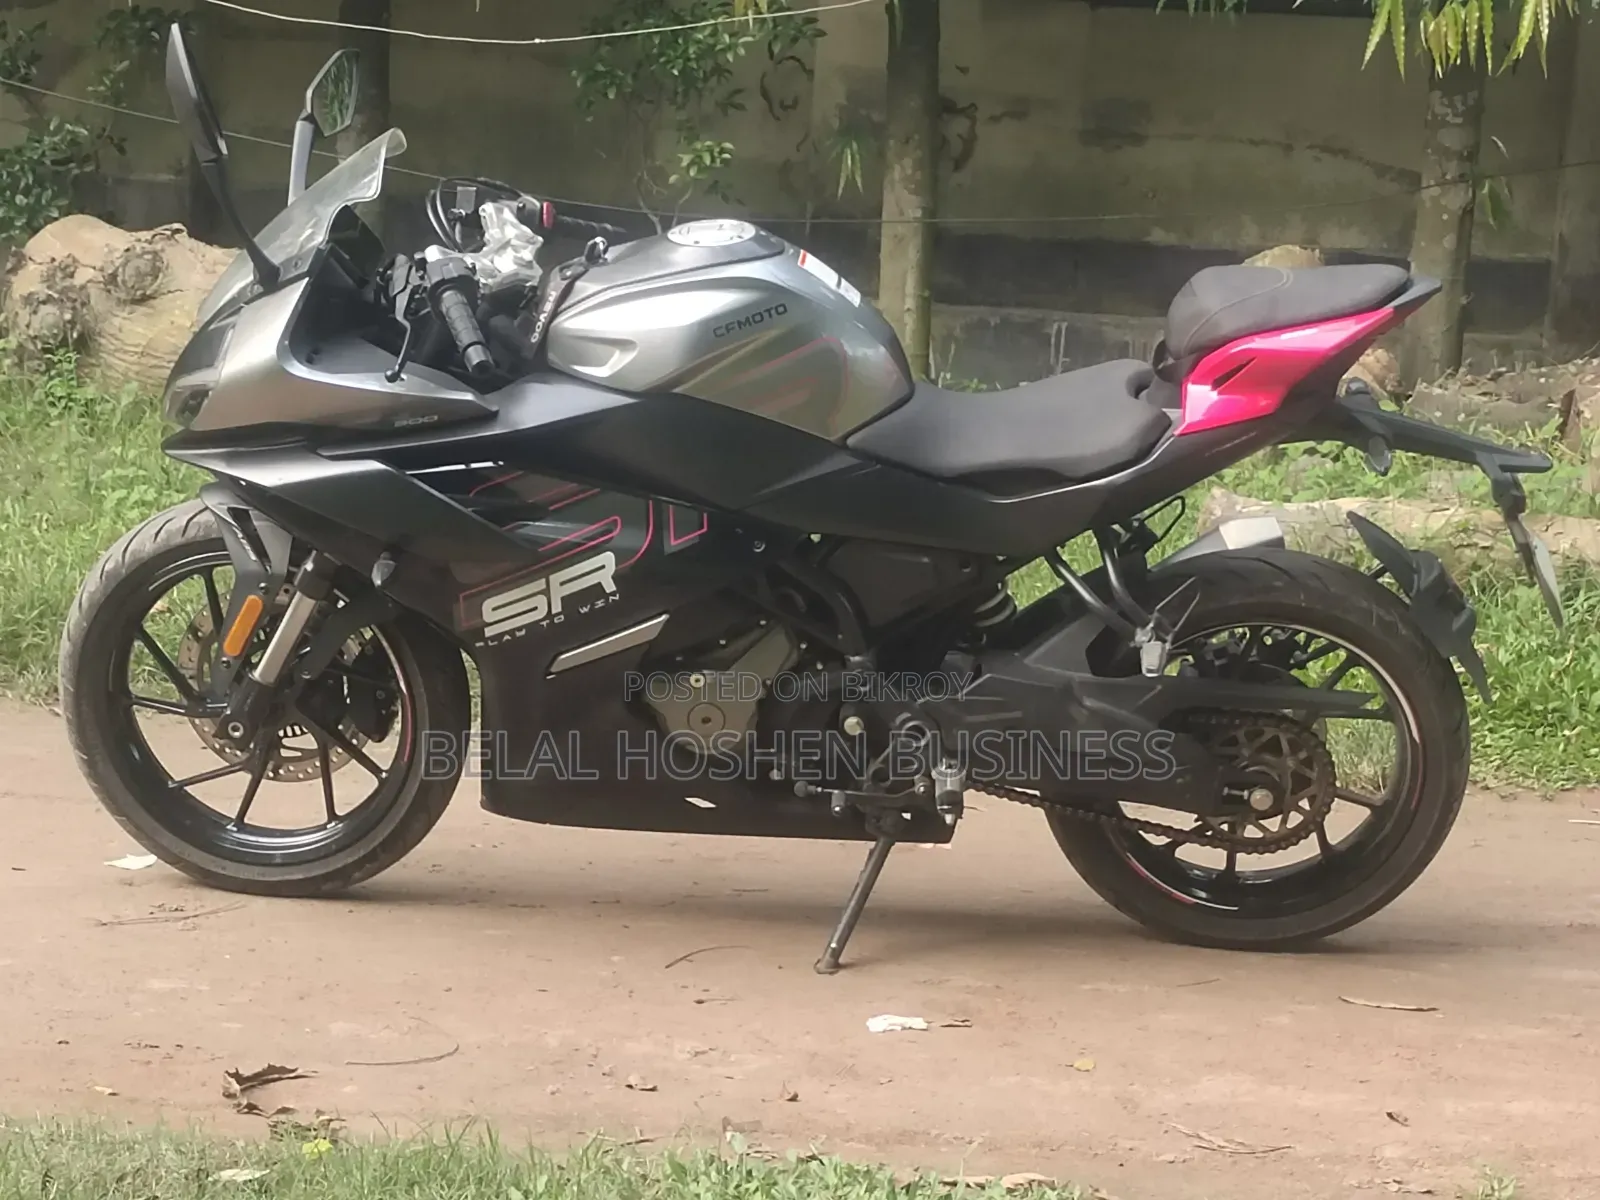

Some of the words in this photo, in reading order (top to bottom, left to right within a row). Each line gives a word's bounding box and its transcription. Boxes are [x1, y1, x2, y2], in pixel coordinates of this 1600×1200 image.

[713, 303, 788, 338] CFMOTO
[482, 551, 617, 638] SR
[540, 614, 565, 628] TO
[578, 593, 620, 614] WIN
